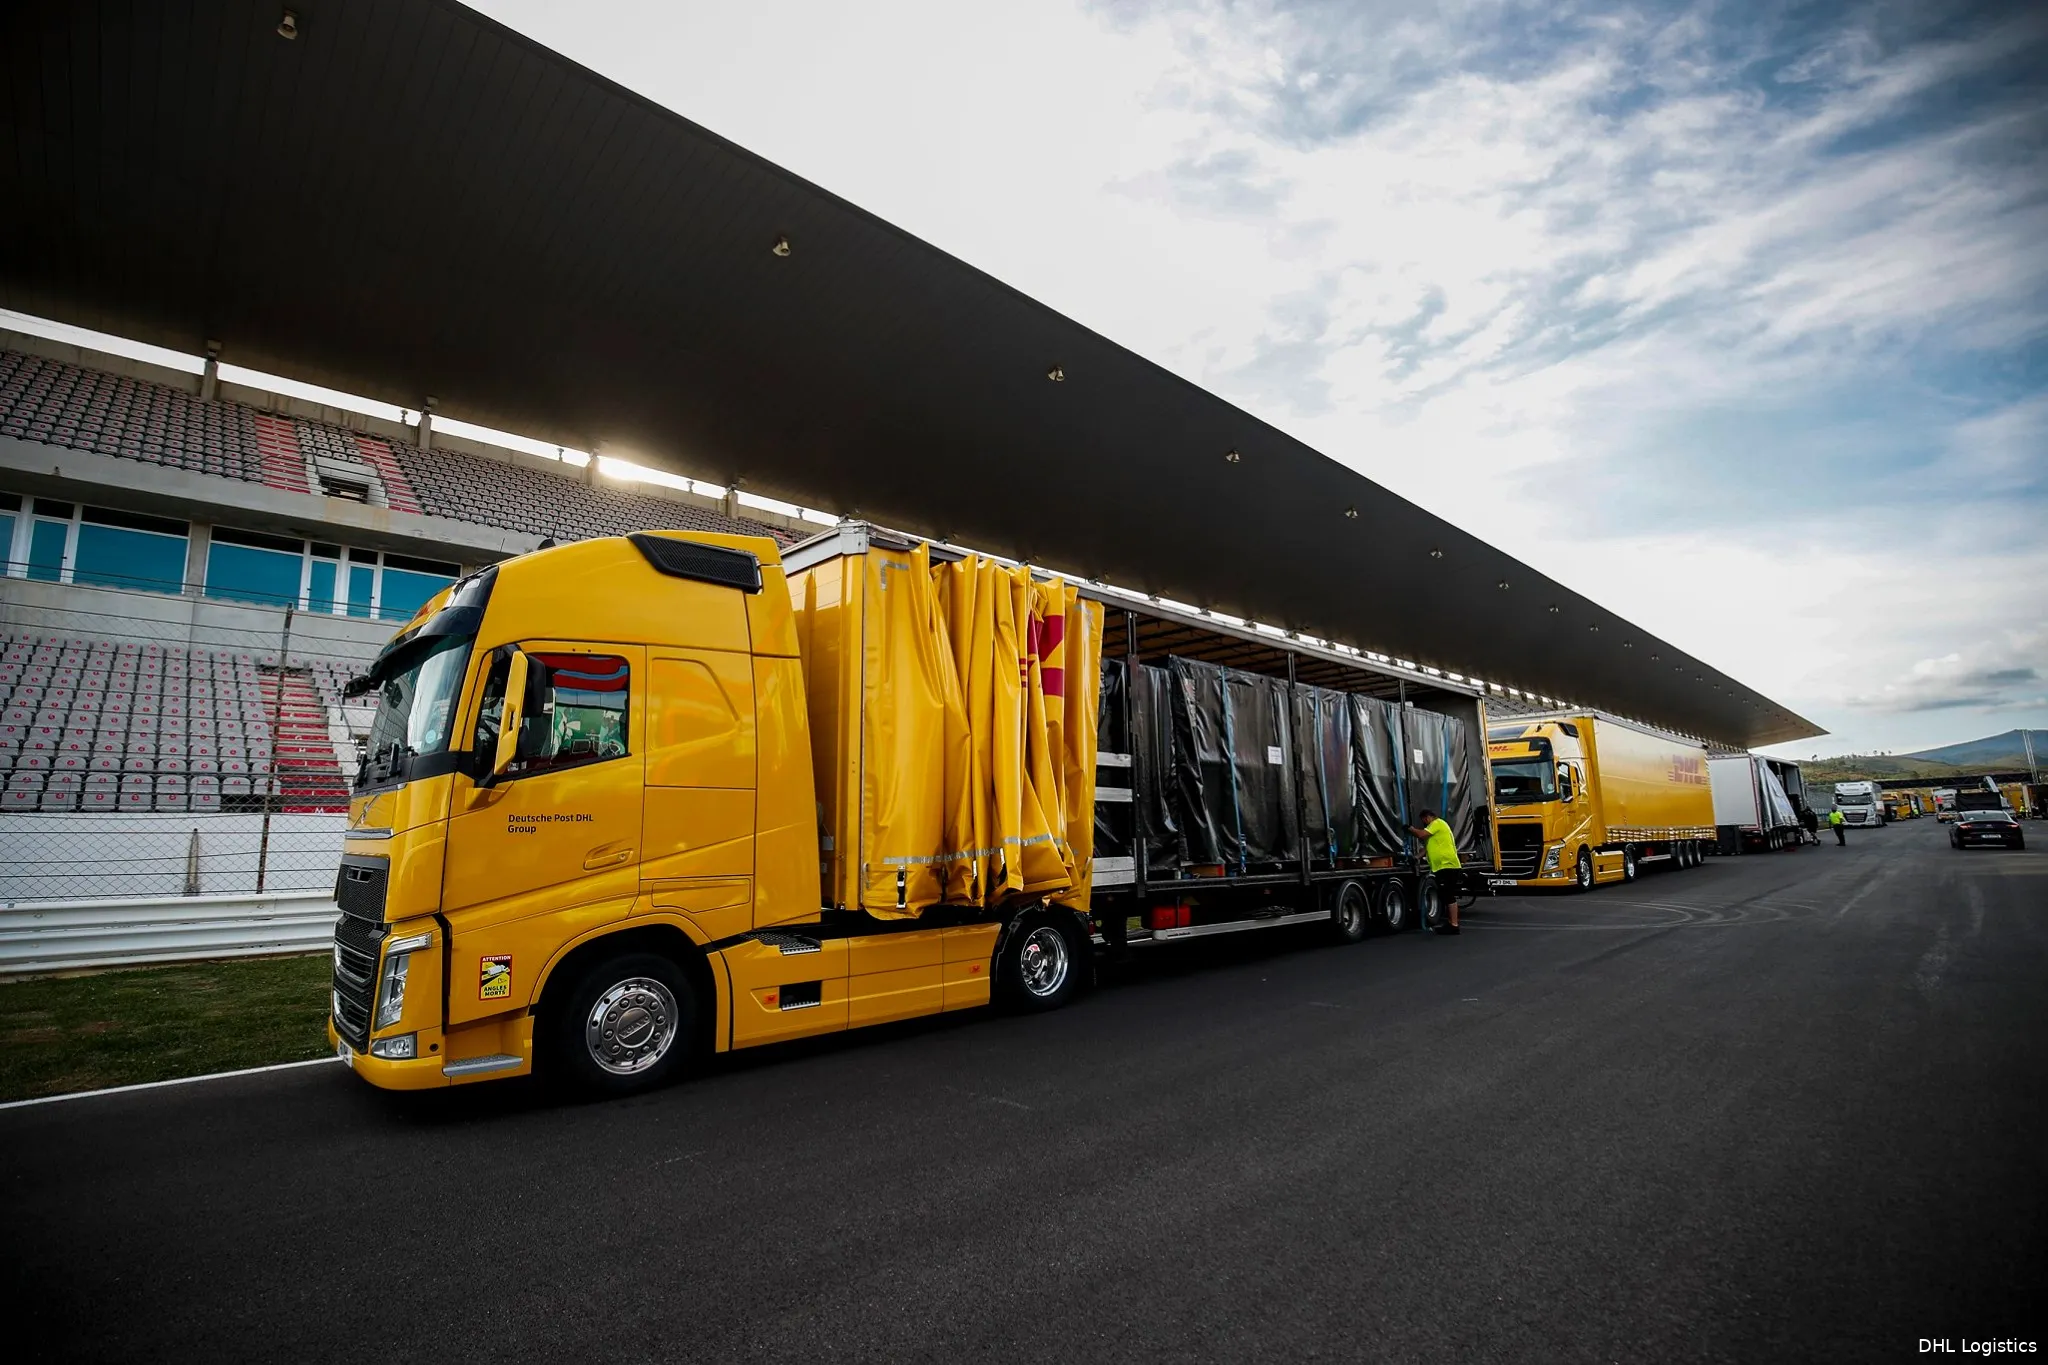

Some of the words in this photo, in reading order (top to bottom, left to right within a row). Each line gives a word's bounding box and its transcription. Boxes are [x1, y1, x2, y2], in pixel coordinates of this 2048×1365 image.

[1671, 754, 1706, 785] DHL
[508, 814, 552, 823] Deutsche
[554, 814, 574, 822] Post
[576, 814, 594, 822] DHL
[507, 825, 537, 835] Group
